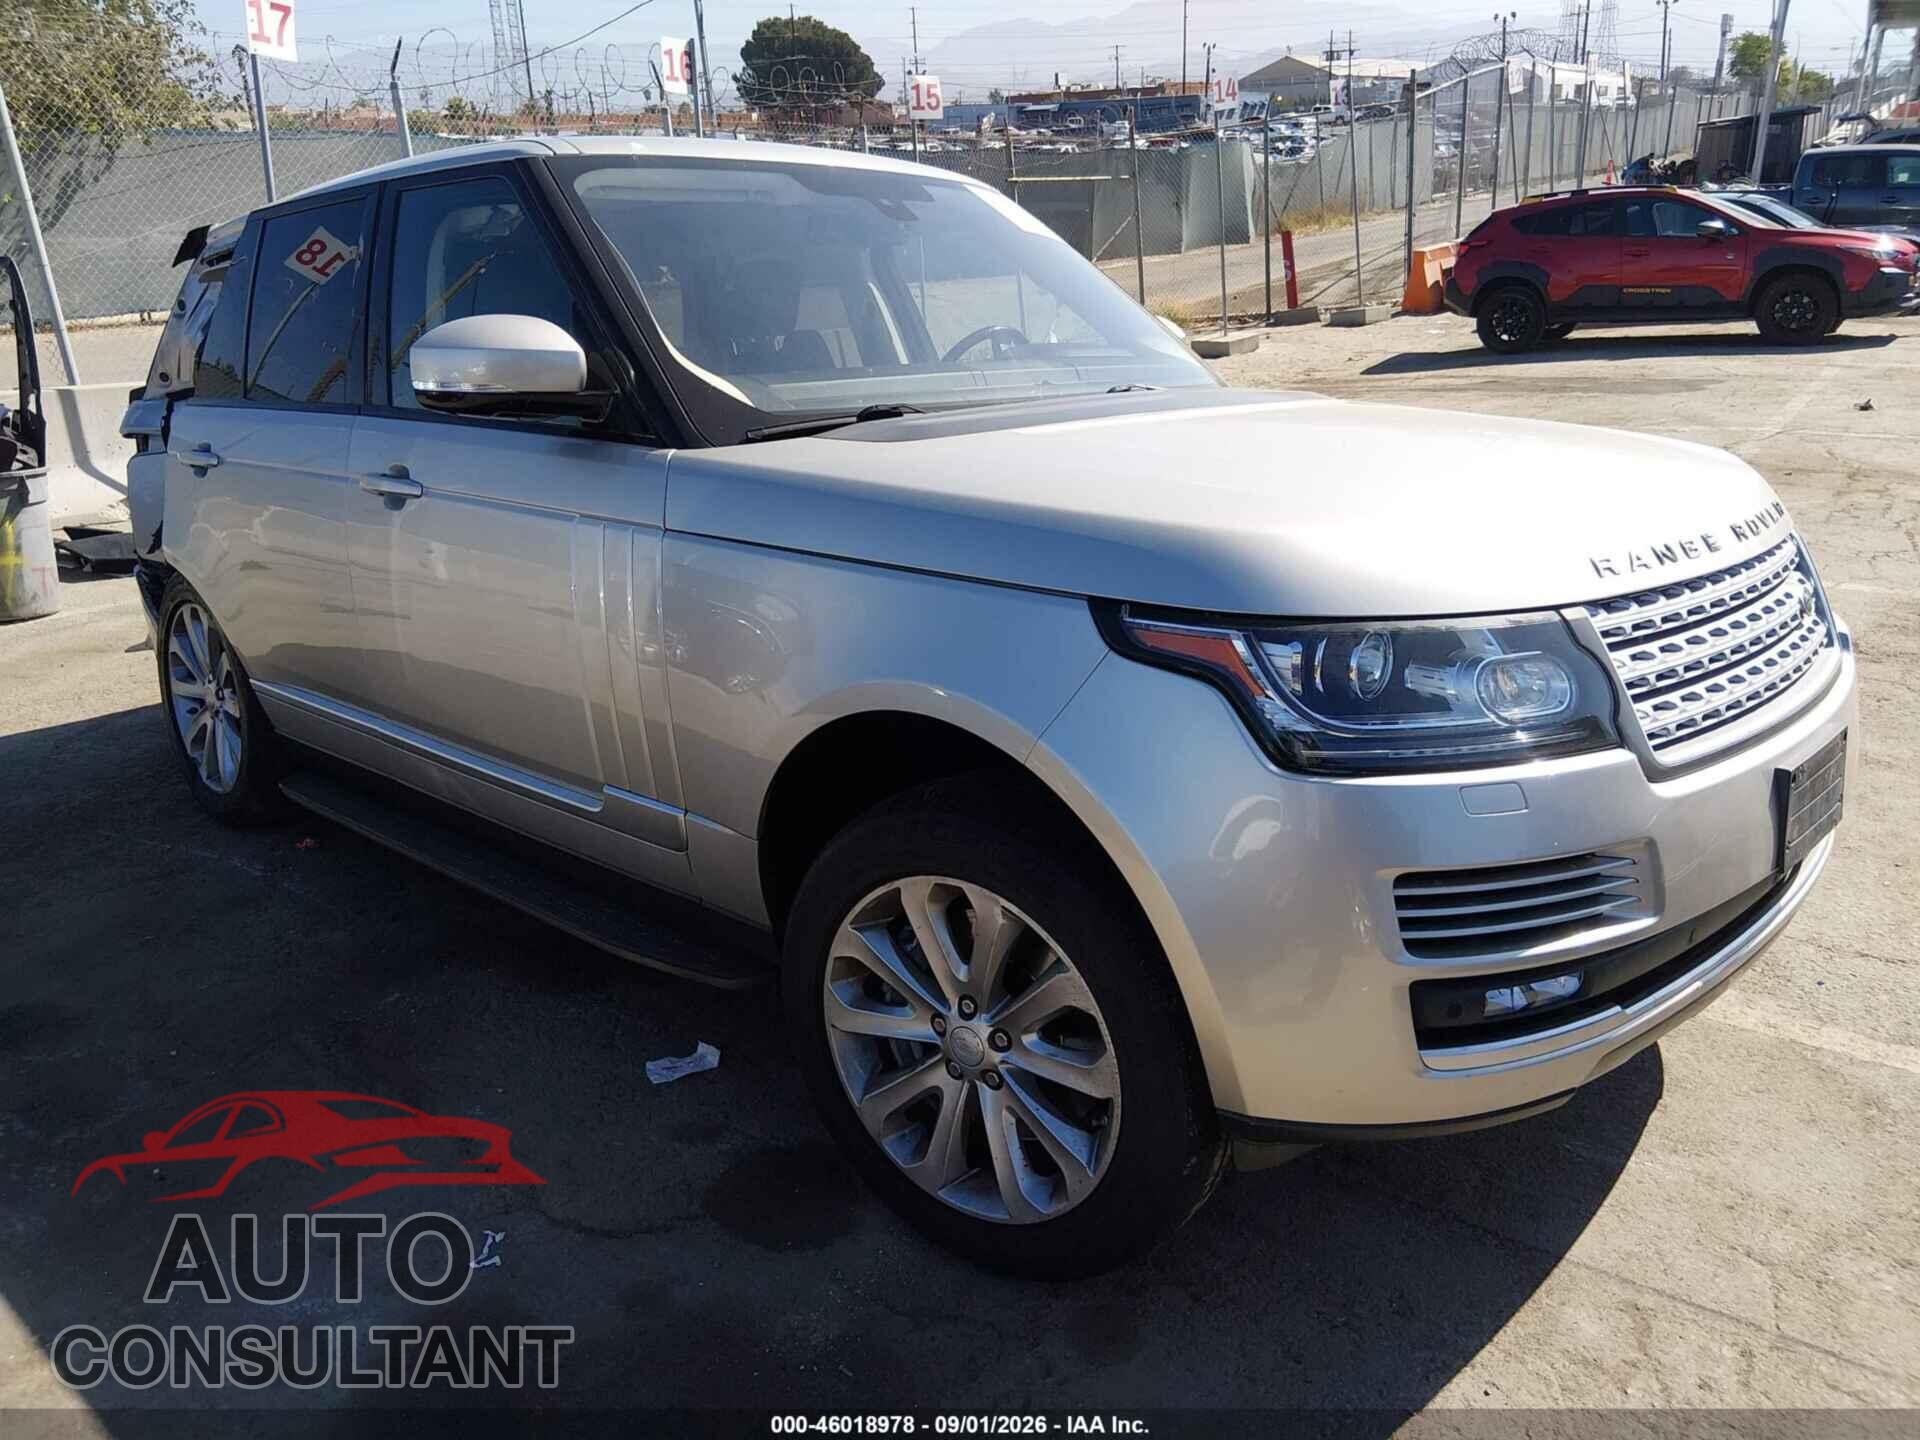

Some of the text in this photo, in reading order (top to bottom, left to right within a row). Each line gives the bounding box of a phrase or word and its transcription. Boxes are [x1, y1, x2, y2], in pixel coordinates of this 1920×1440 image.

[248, 0, 292, 47] 17
[911, 83, 940, 111] 15
[1215, 77, 1237, 103] 14
[1590, 533, 1721, 579] RANGE
